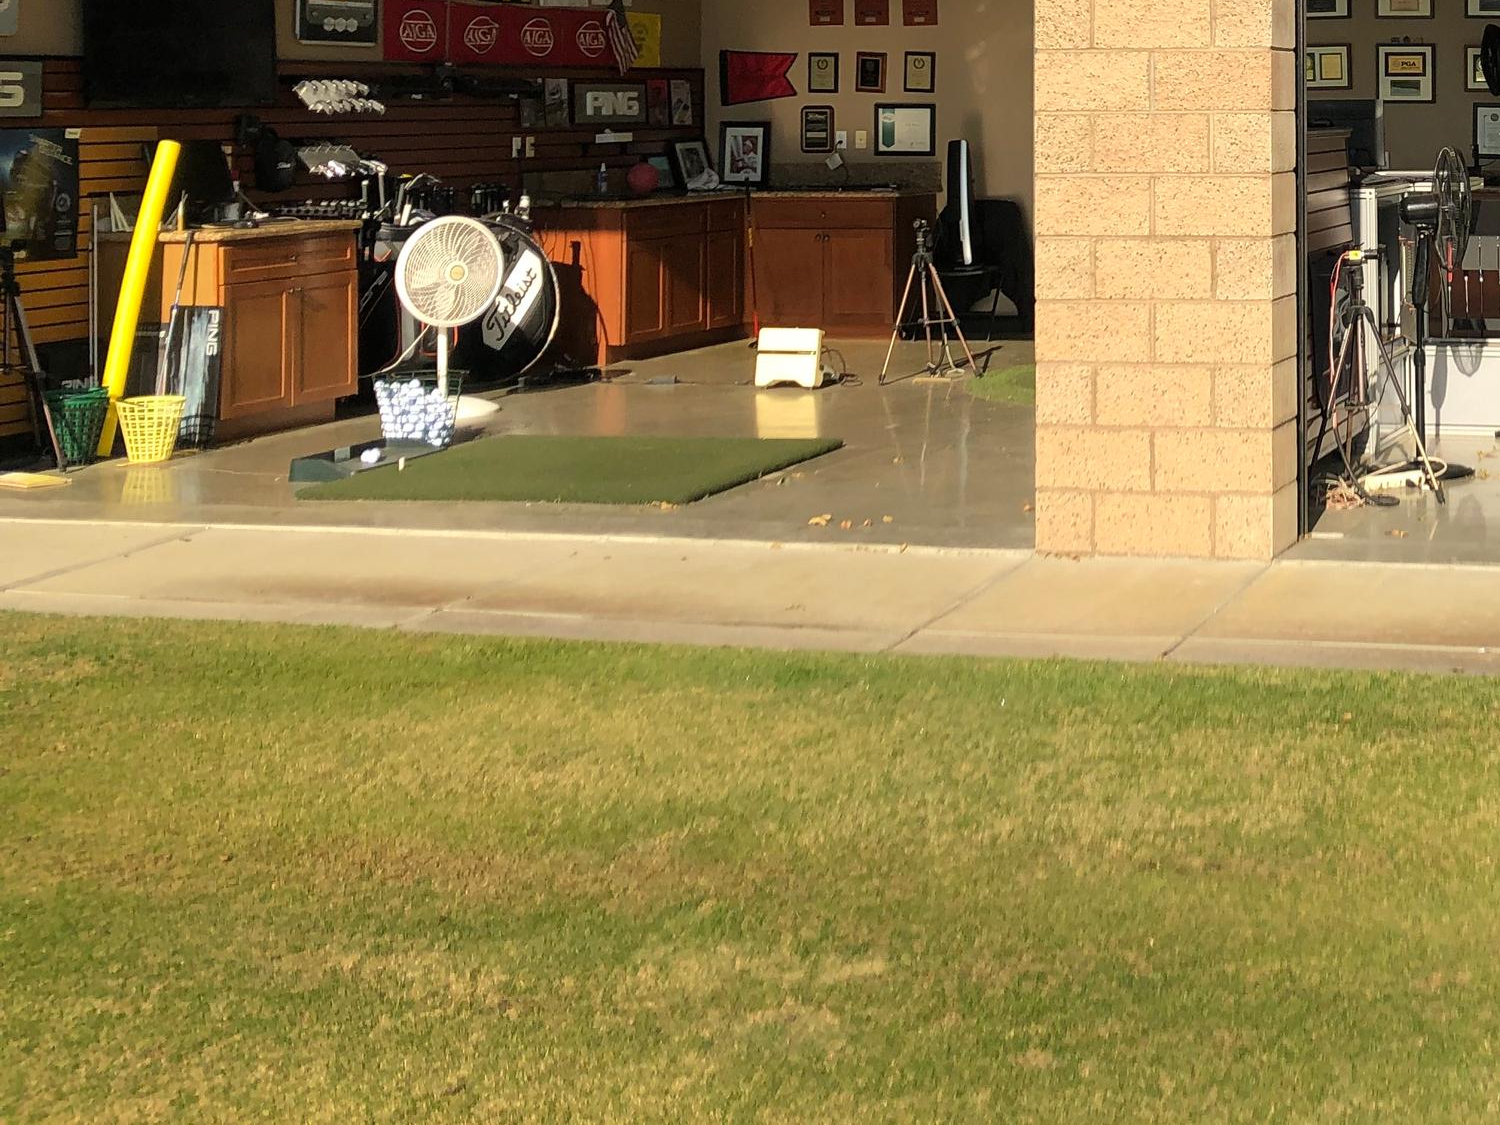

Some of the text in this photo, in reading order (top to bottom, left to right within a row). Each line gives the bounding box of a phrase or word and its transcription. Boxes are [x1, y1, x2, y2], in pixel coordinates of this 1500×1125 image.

[402, 24, 434, 40] AJGA
[523, 32, 551, 45] AJGA
[1400, 60, 1417, 68] PGA
[586, 91, 640, 116] PING
[486, 267, 537, 342] Titleist
[205, 309, 219, 356] PING
[60, 376, 97, 388] PIN
